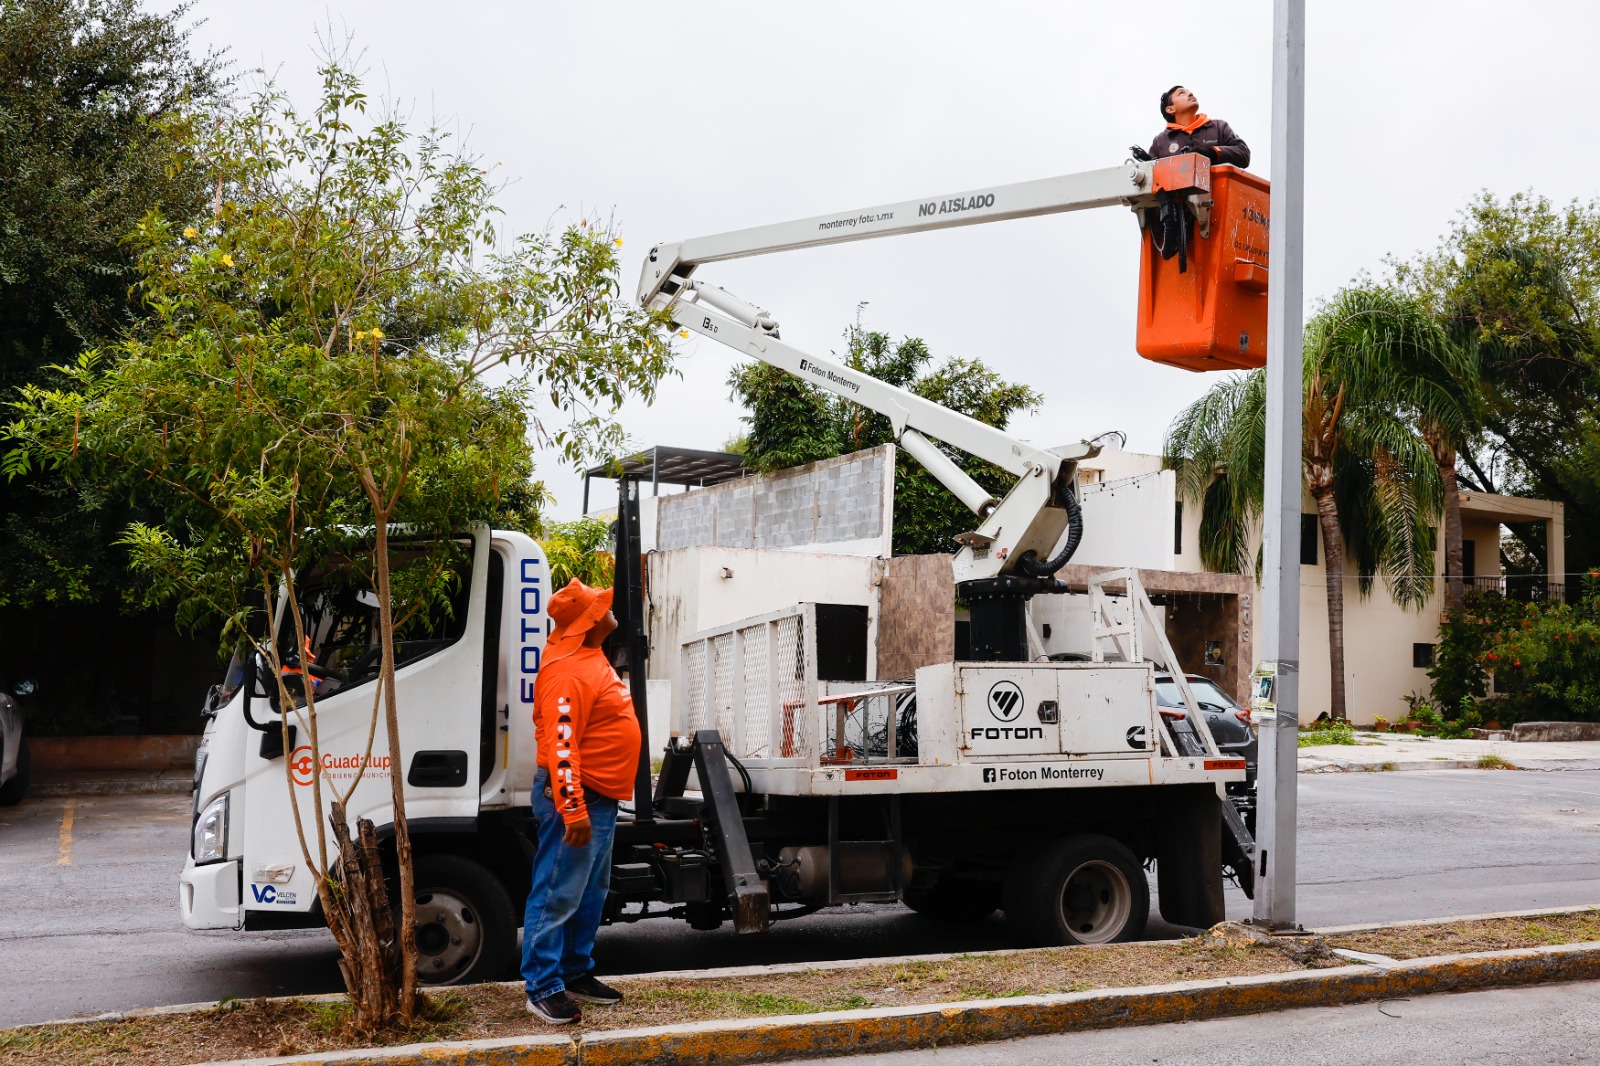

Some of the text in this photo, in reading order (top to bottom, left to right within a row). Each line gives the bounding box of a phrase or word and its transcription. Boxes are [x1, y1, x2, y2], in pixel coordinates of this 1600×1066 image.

[918, 193, 995, 217] NO AISLADO
[818, 217, 858, 230] monterrey
[808, 362, 826, 378] Foton
[827, 371, 861, 394] Monterrey
[521, 559, 540, 703] FOTON
[971, 728, 1043, 740] FOTON
[322, 753, 391, 770] Guadalup
[1000, 768, 1037, 781] Foton
[1041, 766, 1104, 781] Monterrey
[251, 884, 276, 903] VC
